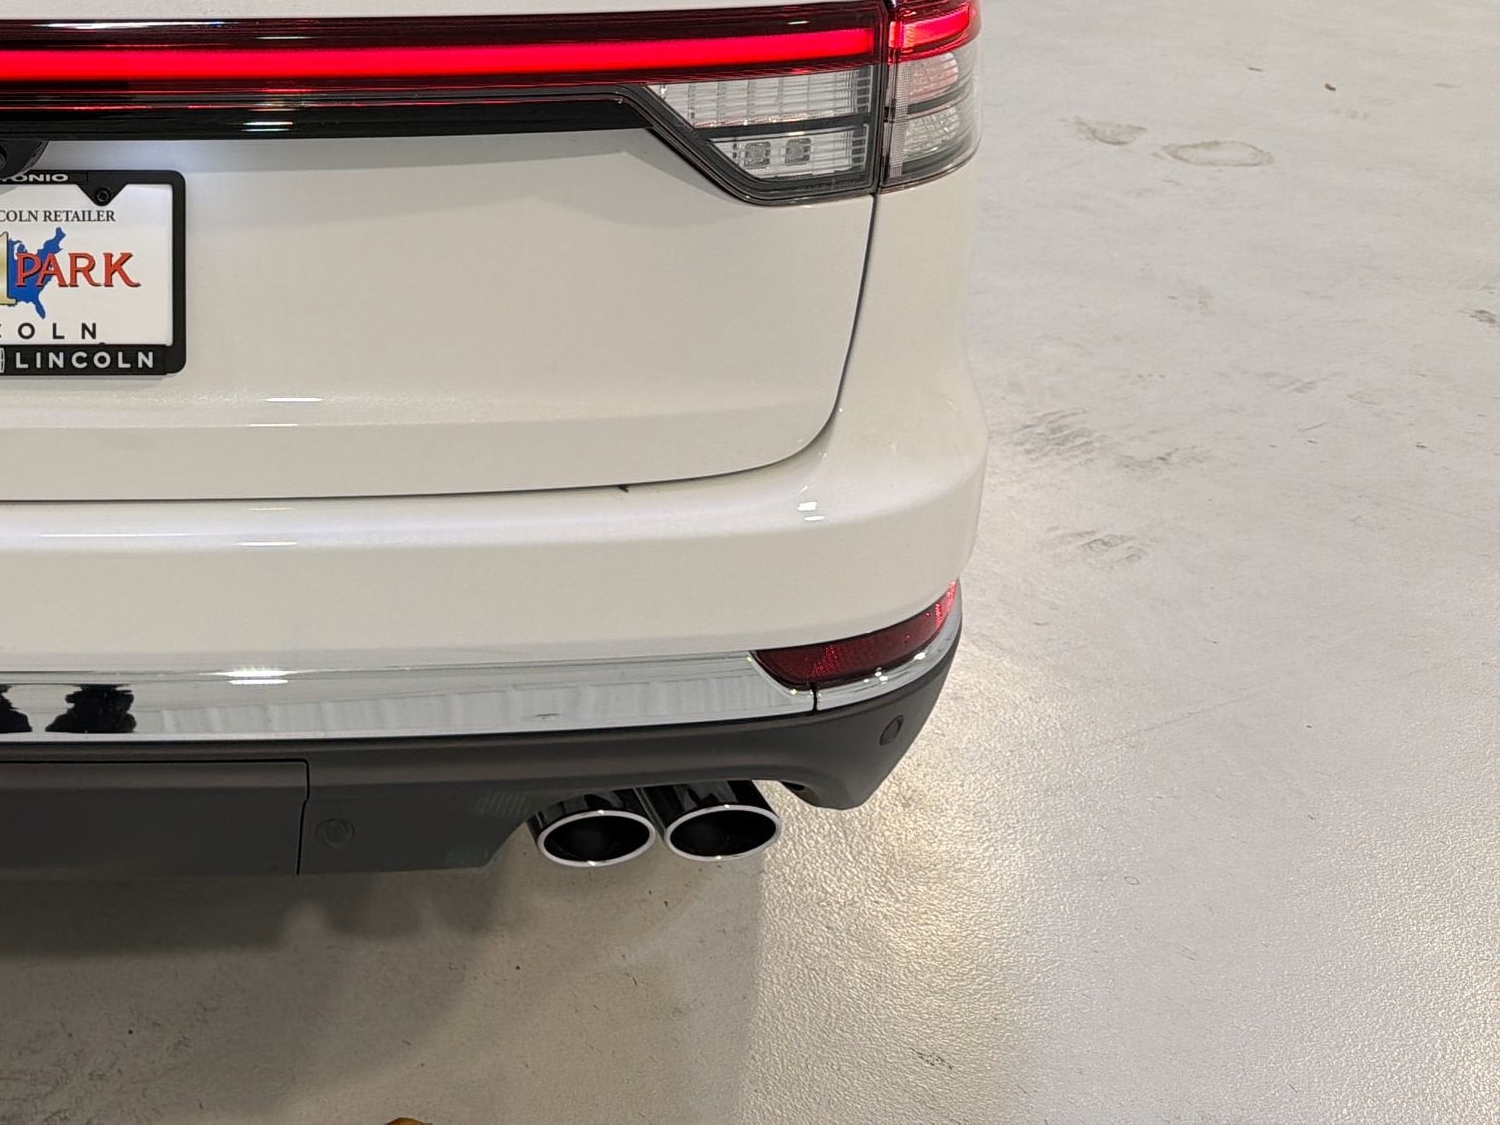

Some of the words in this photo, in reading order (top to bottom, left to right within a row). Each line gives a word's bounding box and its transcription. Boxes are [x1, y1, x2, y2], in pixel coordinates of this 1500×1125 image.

[43, 211, 116, 222] RETAILER
[16, 251, 142, 288] PARK
[15, 351, 155, 369] LINCOLN
